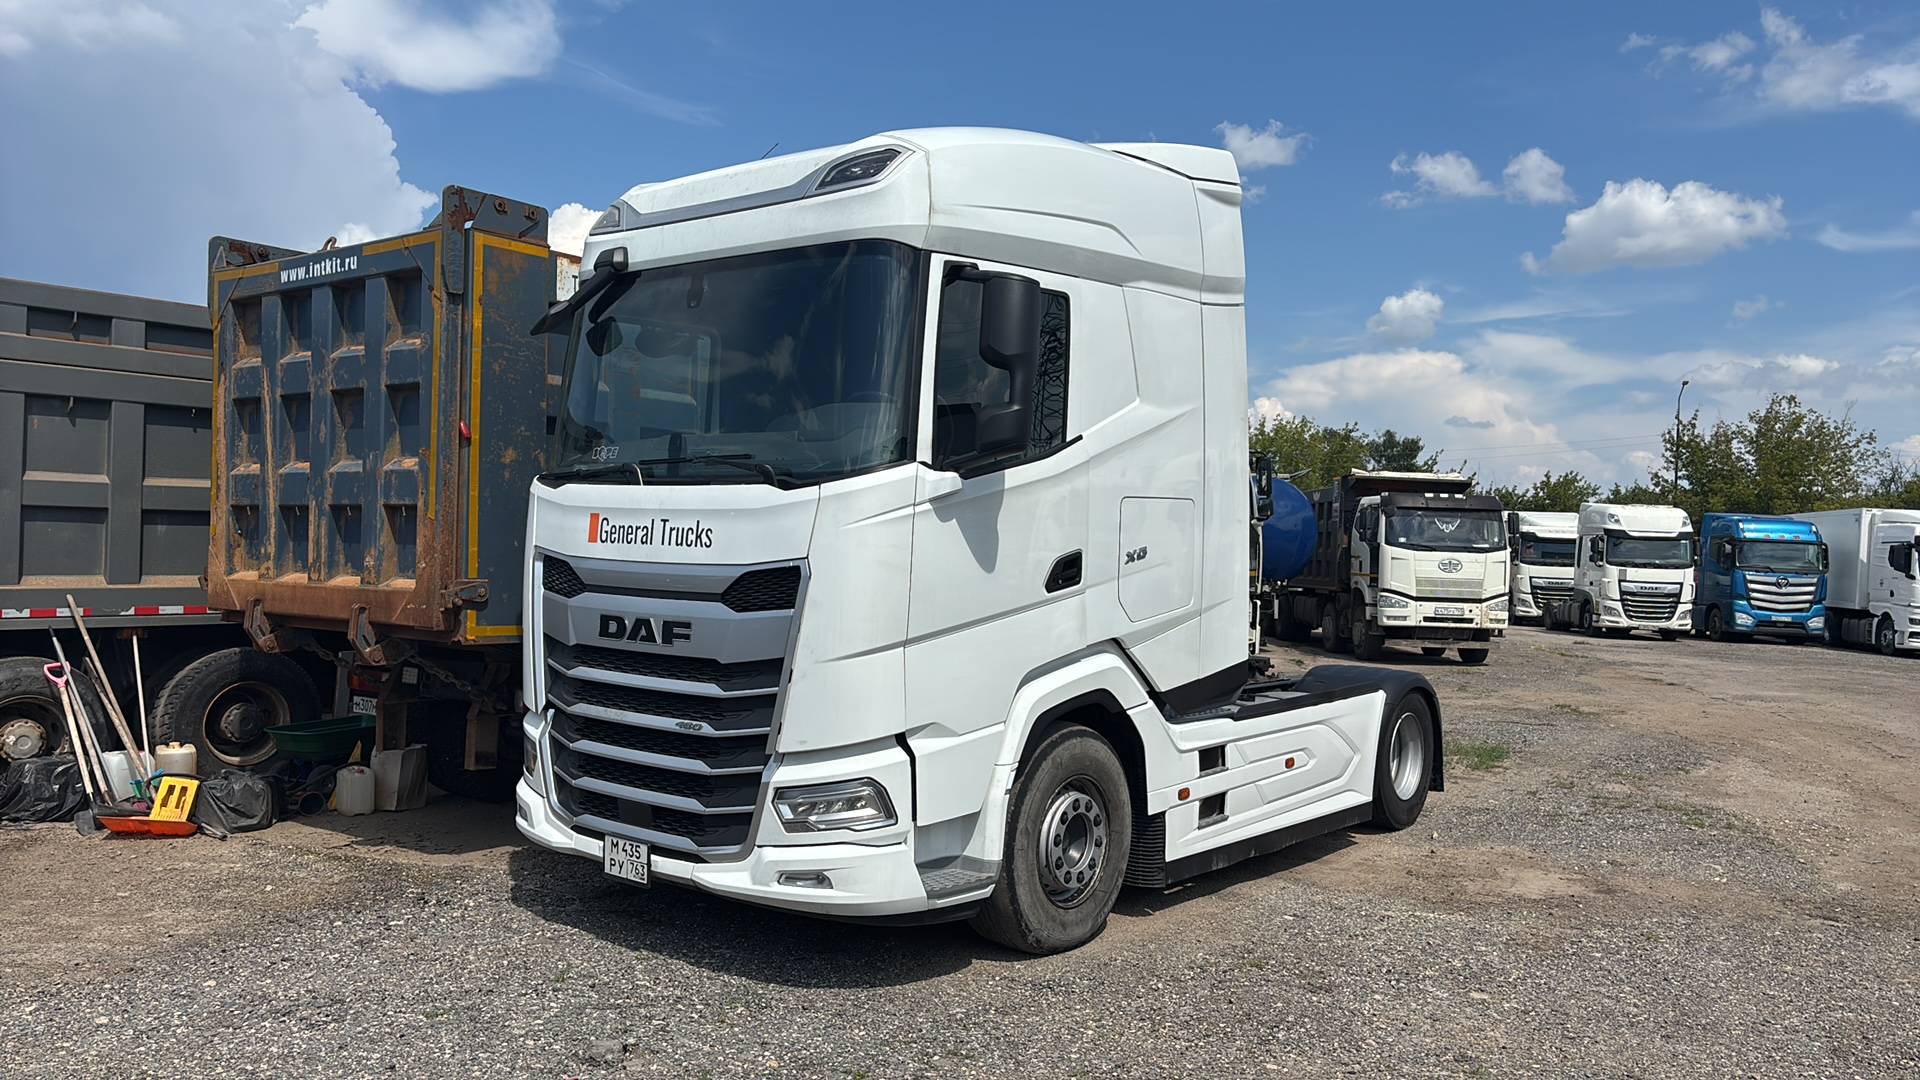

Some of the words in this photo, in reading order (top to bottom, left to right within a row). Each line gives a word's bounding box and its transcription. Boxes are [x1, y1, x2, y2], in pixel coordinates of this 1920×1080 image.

[280, 256, 358, 283] www.intkit.ru
[599, 517, 655, 546] General
[660, 518, 713, 549] Trucks
[598, 613, 693, 647] DAF
[621, 841, 642, 860] 435
[629, 861, 646, 877] 763
